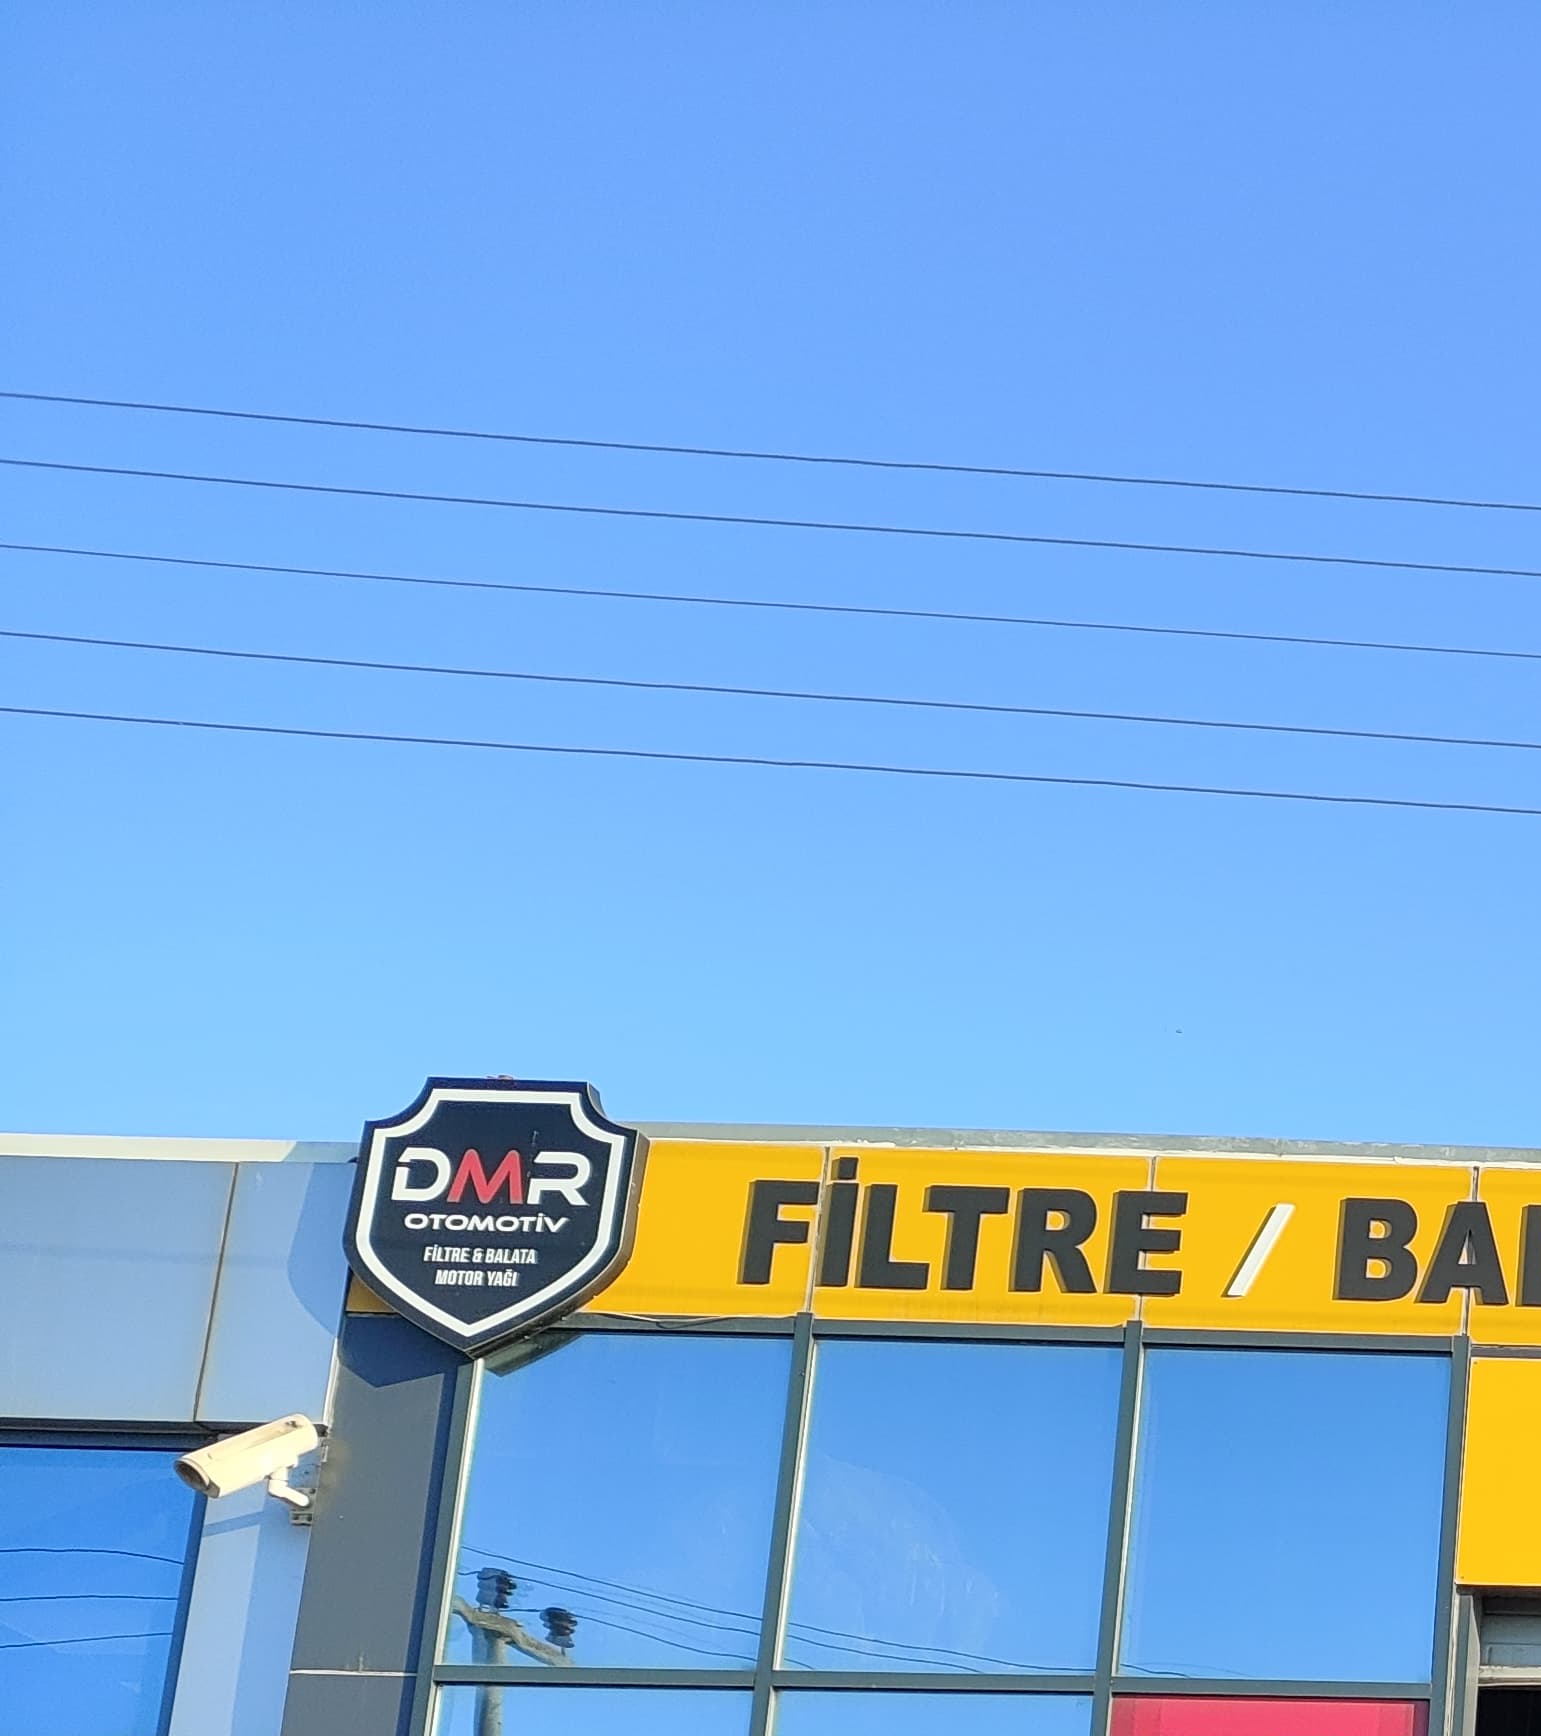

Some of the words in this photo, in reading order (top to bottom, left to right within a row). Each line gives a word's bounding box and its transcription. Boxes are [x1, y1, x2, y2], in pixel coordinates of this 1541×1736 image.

[391, 1146, 591, 1207] DMR
[404, 1212, 569, 1233] OTOMOTİV
[737, 1155, 1188, 1299] FİLTRE
[1223, 1203, 1294, 1298] /
[423, 1244, 470, 1263] FİLTRE
[472, 1249, 483, 1263] &
[485, 1249, 537, 1265] BALATA
[434, 1269, 483, 1286] MOTOR
[486, 1269, 519, 1287] YAĞI
